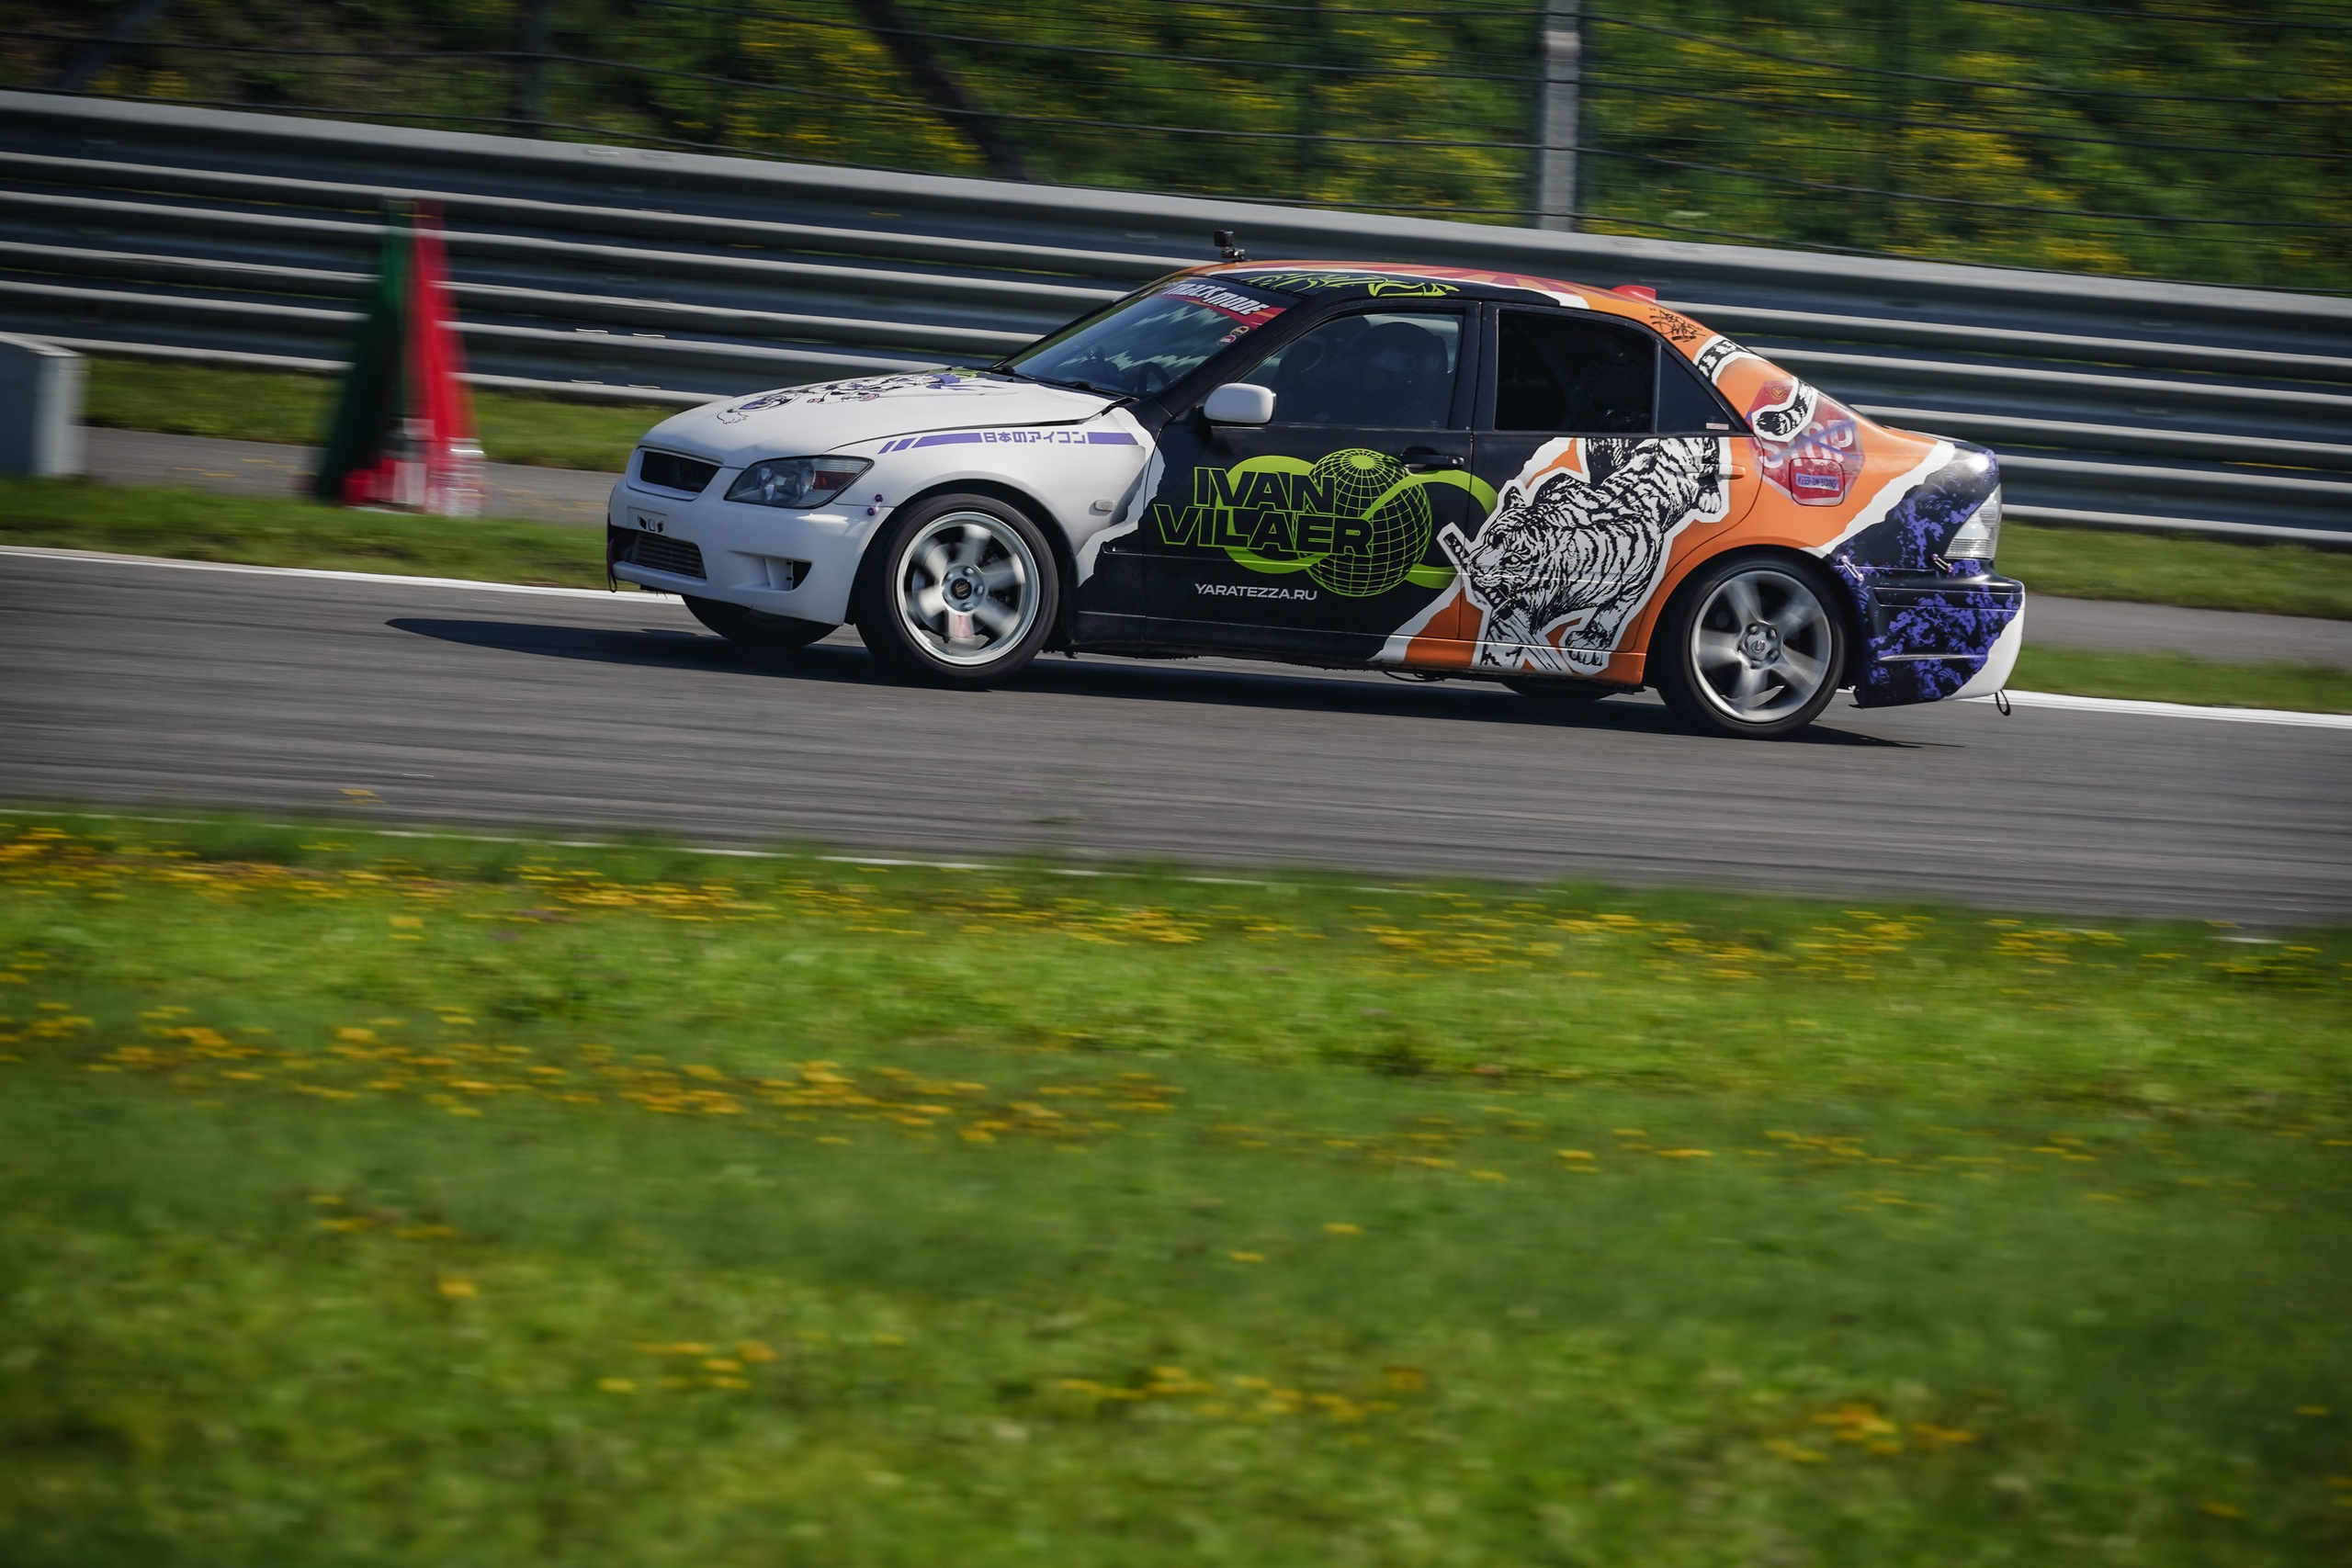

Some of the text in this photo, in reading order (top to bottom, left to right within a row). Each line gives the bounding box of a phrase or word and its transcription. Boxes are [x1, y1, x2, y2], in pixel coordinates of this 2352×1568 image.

[982, 431, 1086, 444] 日本のアイコン
[1194, 466, 1336, 515] IVAN
[1154, 503, 1374, 557] VILAER
[1194, 582, 1317, 601] YARATEZZA.RU
